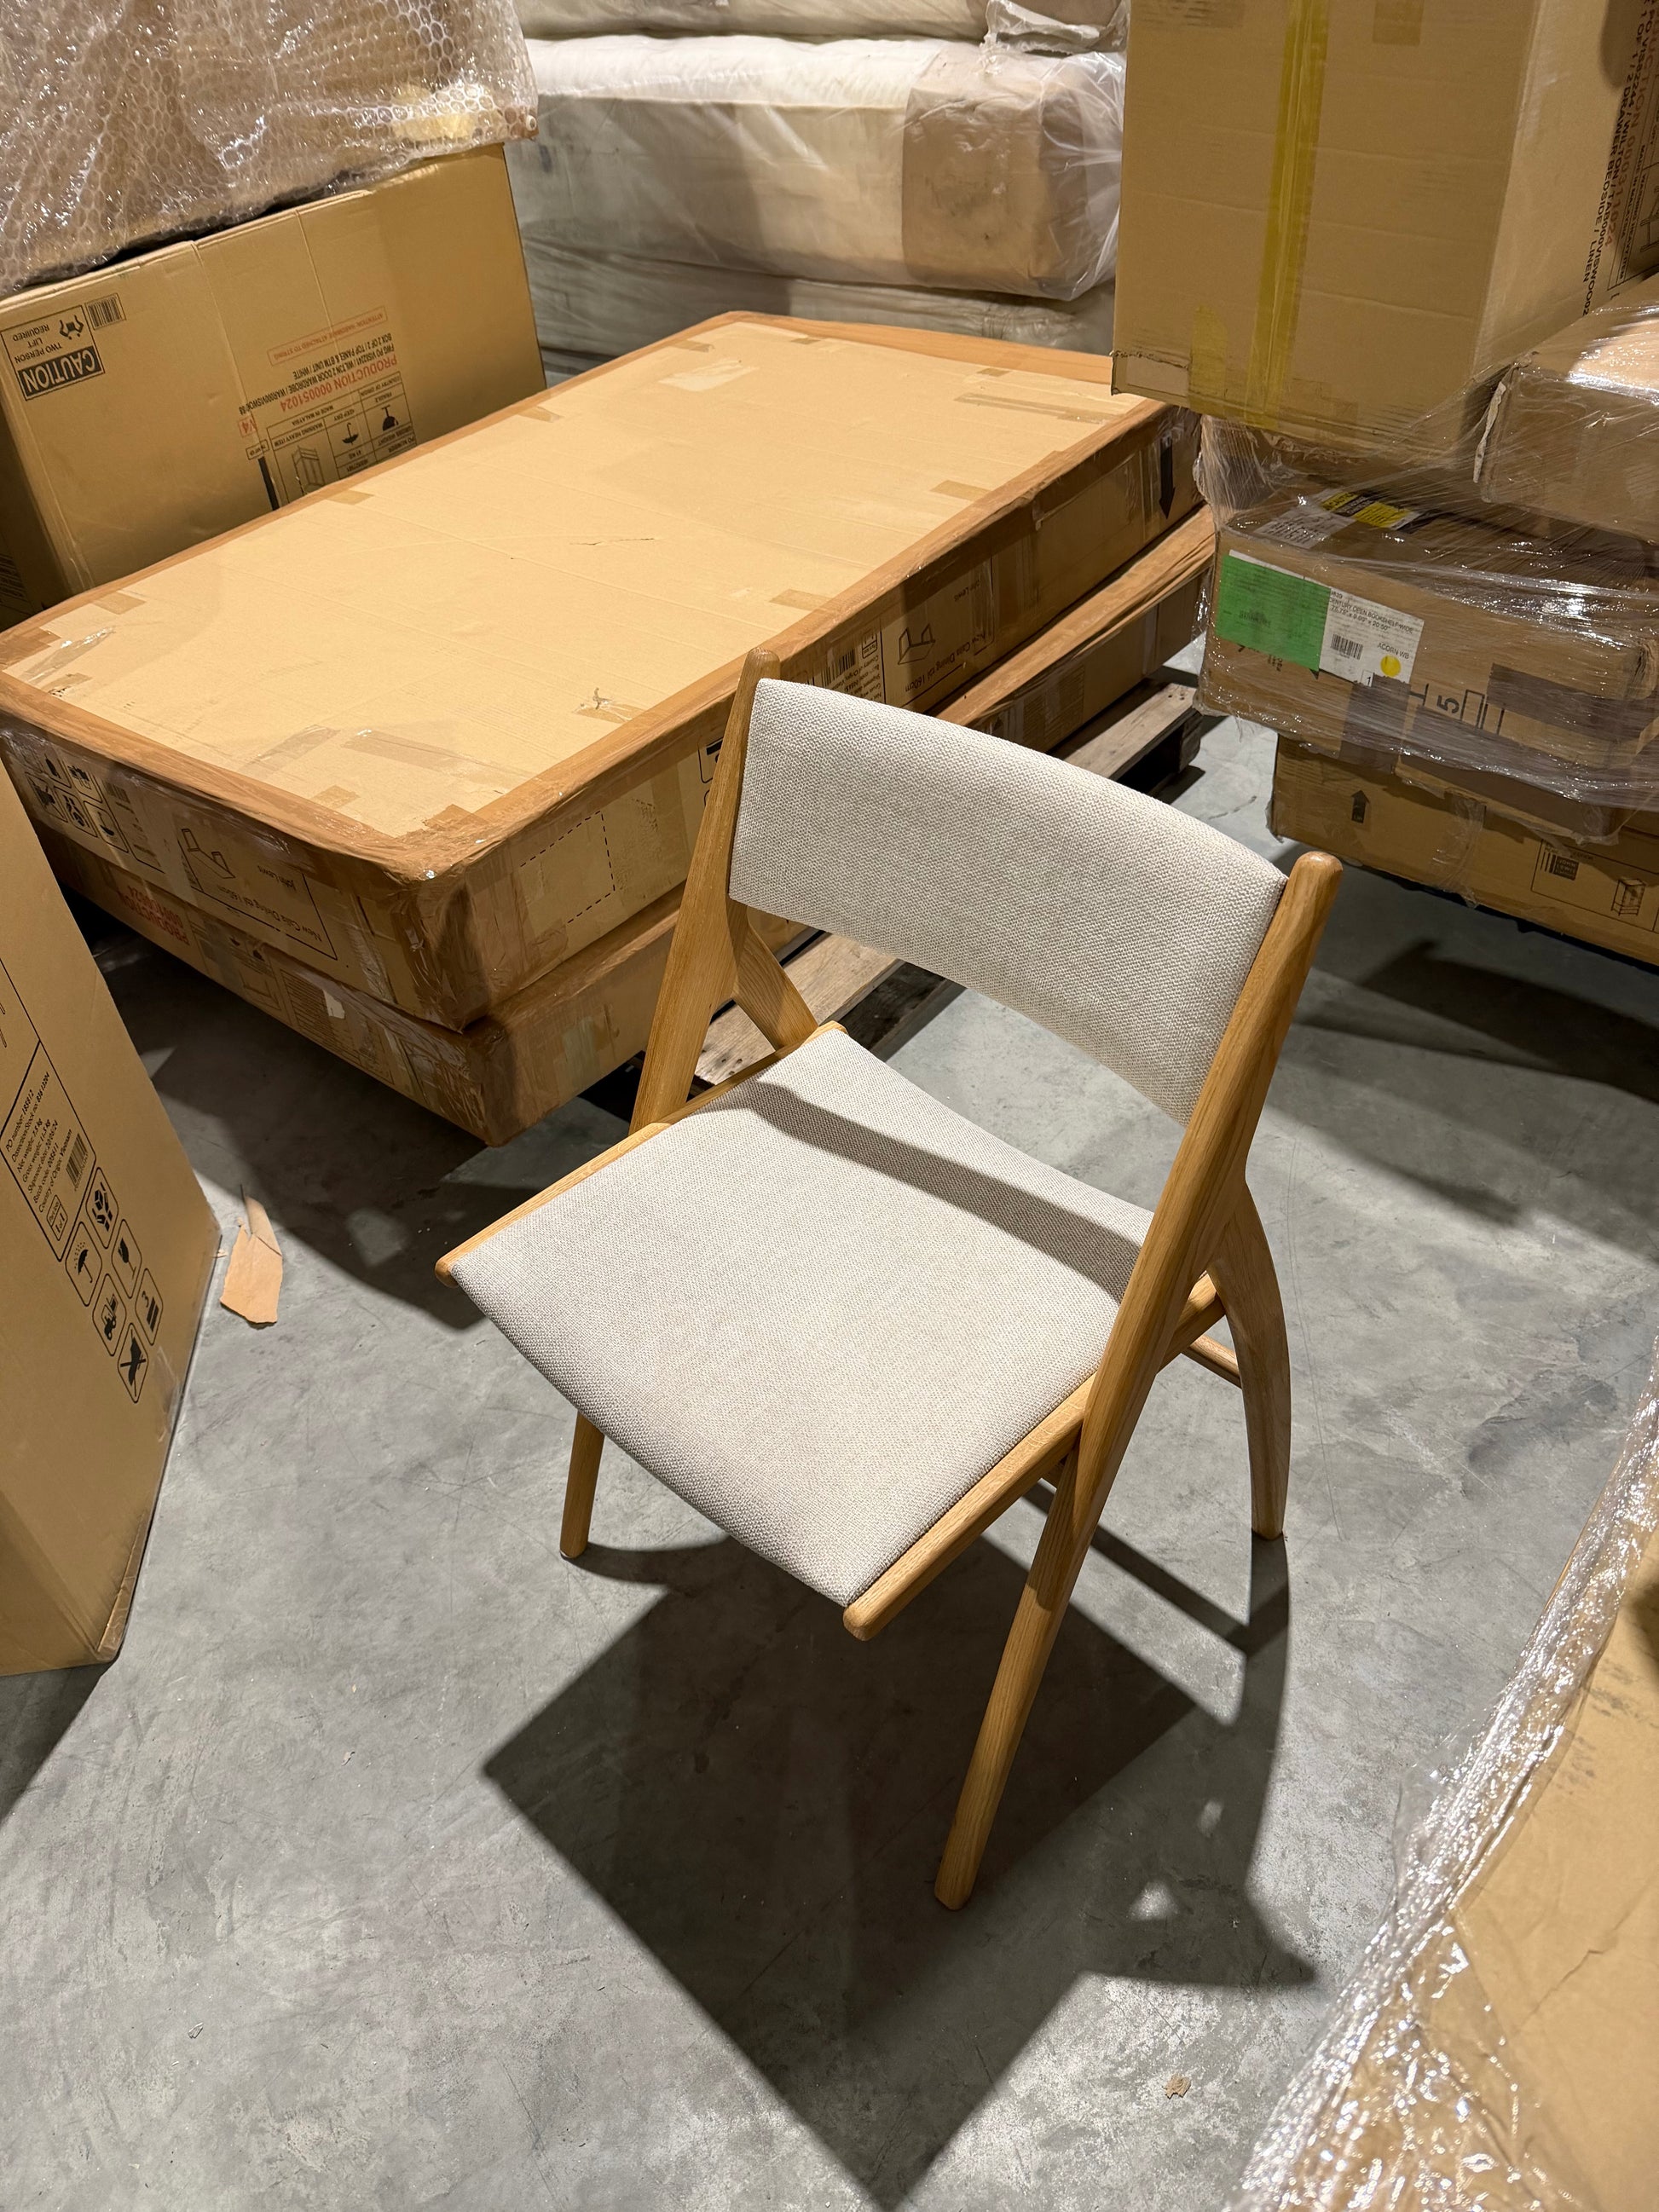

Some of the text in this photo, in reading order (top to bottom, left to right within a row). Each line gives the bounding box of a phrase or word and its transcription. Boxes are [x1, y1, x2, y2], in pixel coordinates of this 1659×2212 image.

[1610, 86, 1630, 156] DRAWER
[1612, 120, 1630, 180] WILTON
[1583, 240, 1597, 281] LINEN
[13, 325, 49, 341] REQUIRED
[28, 338, 43, 348] LIFT
[14, 342, 61, 363] TWO PERSON
[22, 350, 95, 392] CAUTION
[292, 367, 309, 380] WHITE
[279, 354, 396, 411] PRODUCTION 000051024
[287, 374, 317, 394] WARDROBE
[291, 412, 315, 426] MALAYSIA
[1377, 642, 1409, 659] ACORN WB
[1367, 676, 1371, 684] 1
[1436, 695, 1460, 713] 5
[5, 1139, 12, 1152] PO
[142, 1291, 151, 1308] 3
